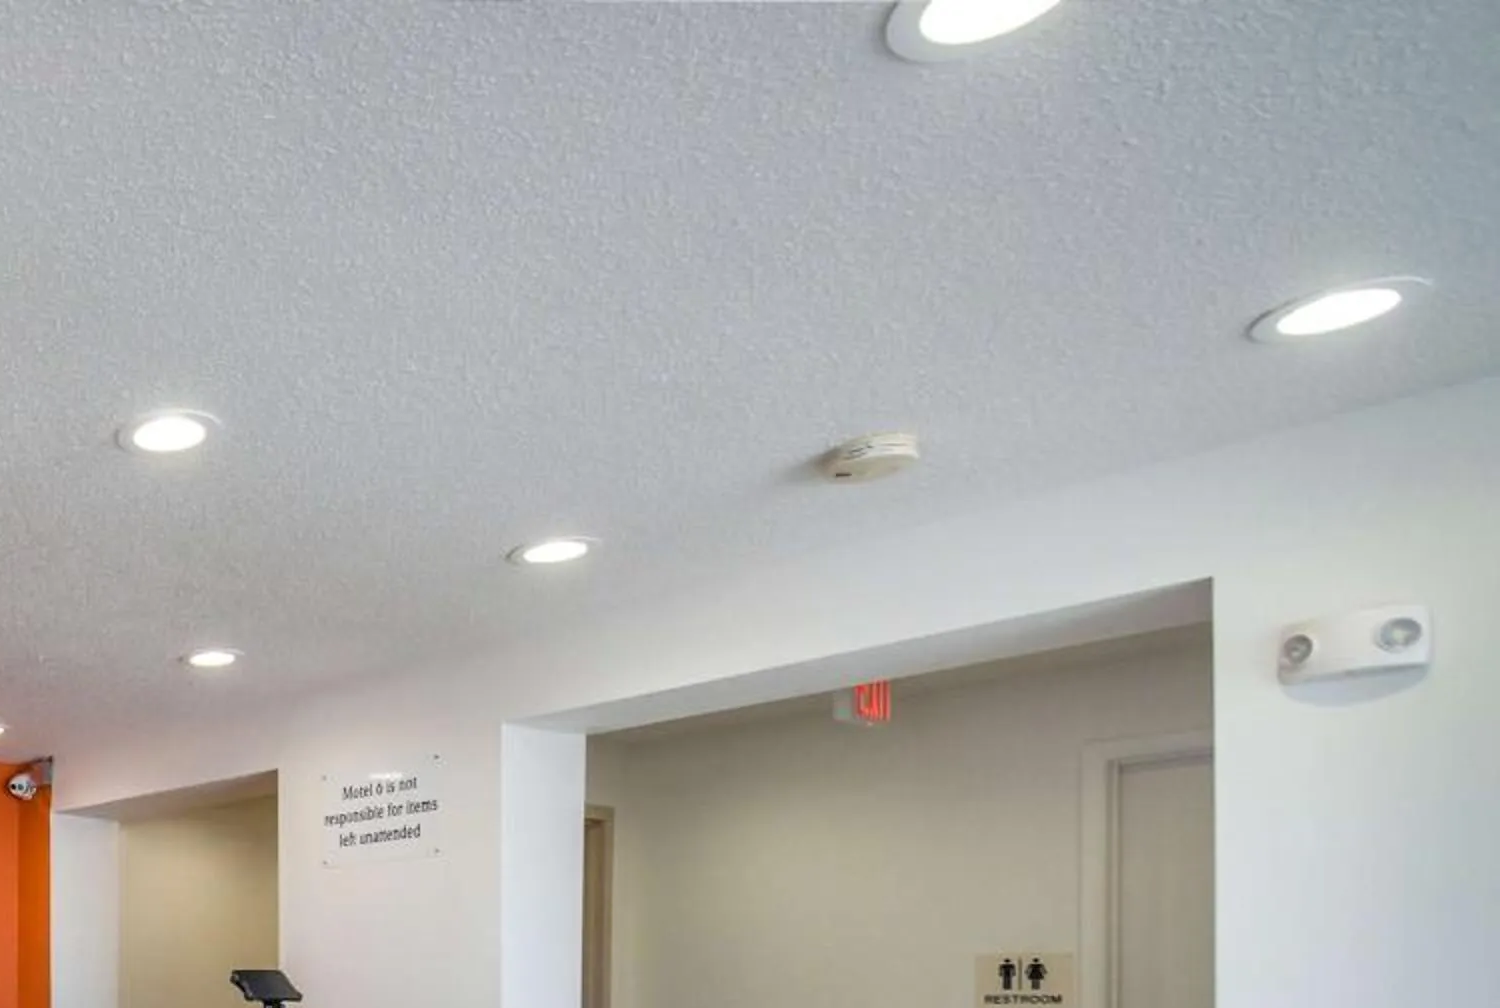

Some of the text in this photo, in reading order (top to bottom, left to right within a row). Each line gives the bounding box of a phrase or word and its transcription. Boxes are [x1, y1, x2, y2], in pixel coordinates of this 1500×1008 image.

[342, 784, 373, 800] Motel
[386, 780, 395, 793] is
[399, 777, 418, 791] not
[324, 800, 438, 827] responsible for items
[339, 832, 356, 848] left
[983, 994, 1063, 1006] RESTROOM
